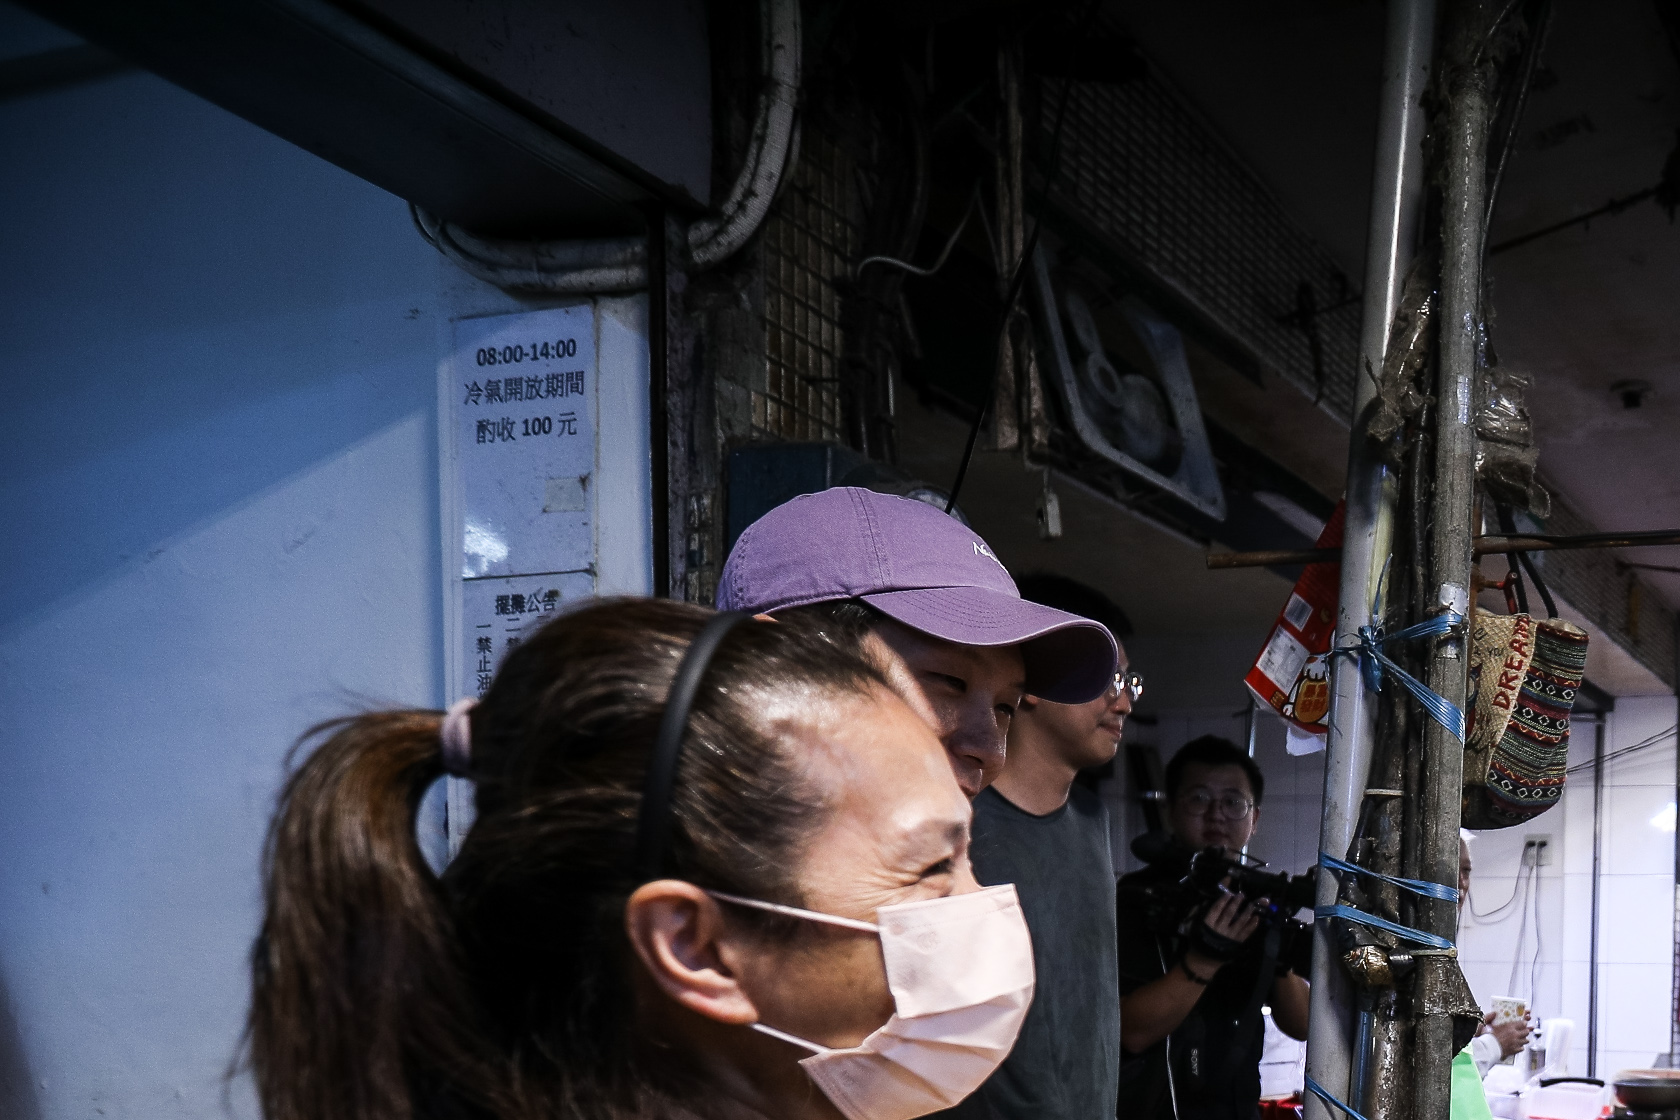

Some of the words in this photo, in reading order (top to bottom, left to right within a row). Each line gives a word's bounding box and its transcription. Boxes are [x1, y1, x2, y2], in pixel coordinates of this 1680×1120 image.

[477, 338, 577, 366] 08:00-14:00
[463, 370, 585, 405] 冷氣開放期間
[476, 416, 516, 444] 酌收
[522, 416, 552, 436] 100
[557, 411, 578, 437] 元
[1190, 1048, 1198, 1076] SONY
